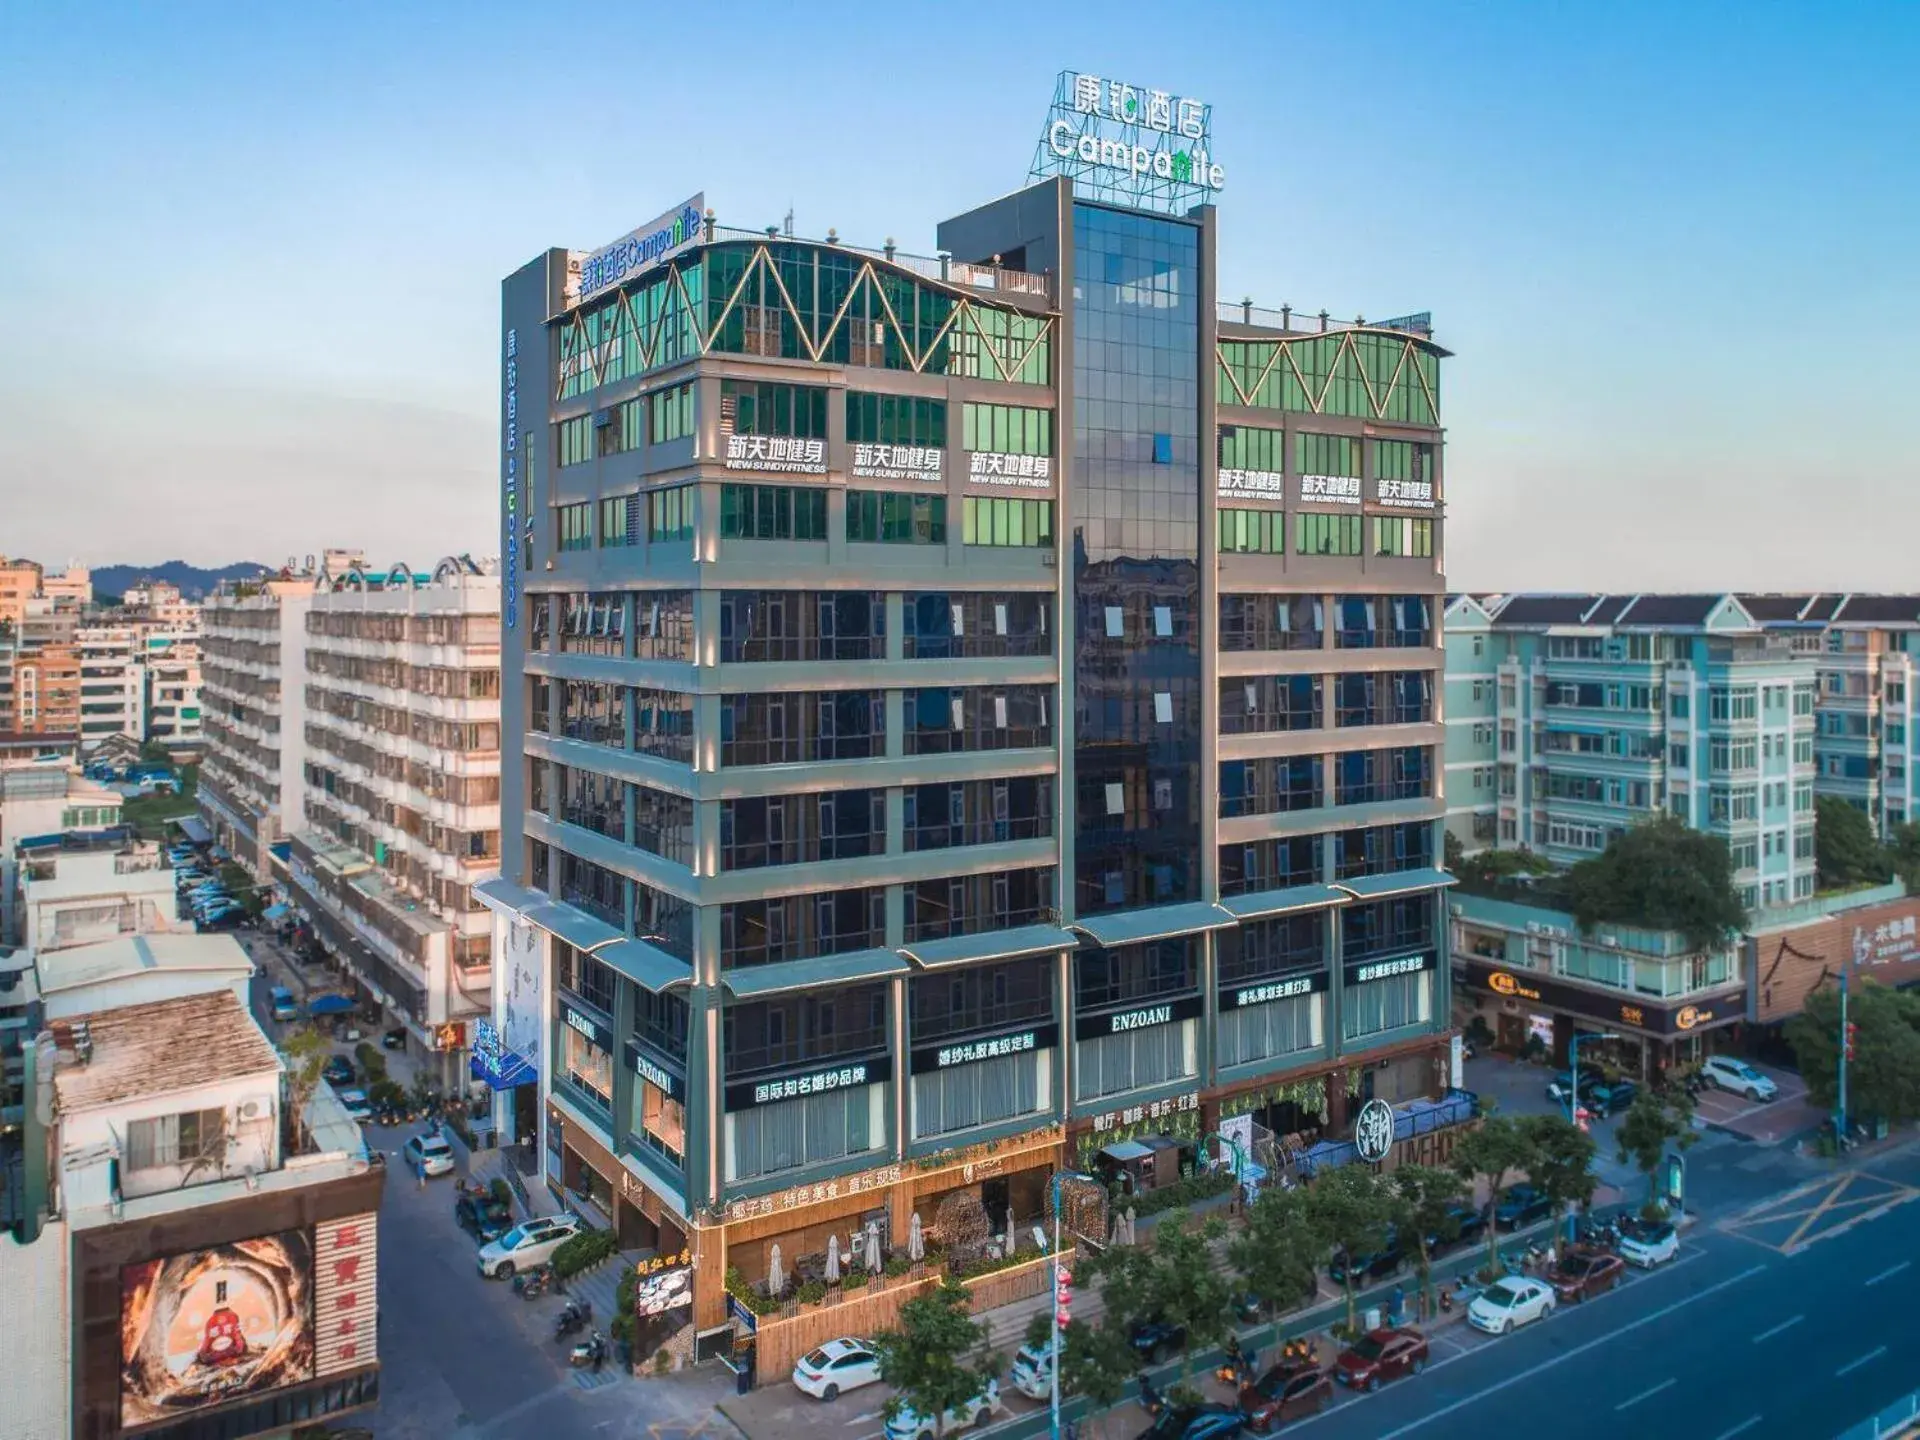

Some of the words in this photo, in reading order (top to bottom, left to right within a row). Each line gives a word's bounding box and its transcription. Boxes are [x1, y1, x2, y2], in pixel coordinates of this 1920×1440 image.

[1074, 74, 1204, 139] 康铂酒店
[1050, 119, 1225, 190] Campanile
[628, 205, 701, 269] Campanile
[727, 435, 823, 462] 新天地健身
[854, 444, 941, 470] 新天地健身
[726, 460, 752, 470] NEW
[852, 467, 874, 477] NEW
[970, 452, 1050, 477] 新天地健身
[1111, 1006, 1171, 1032] ENZOANI
[938, 1033, 1035, 1067] 婚纱礼服高级定制
[755, 1066, 866, 1103] 国际知名婚纱品牌
